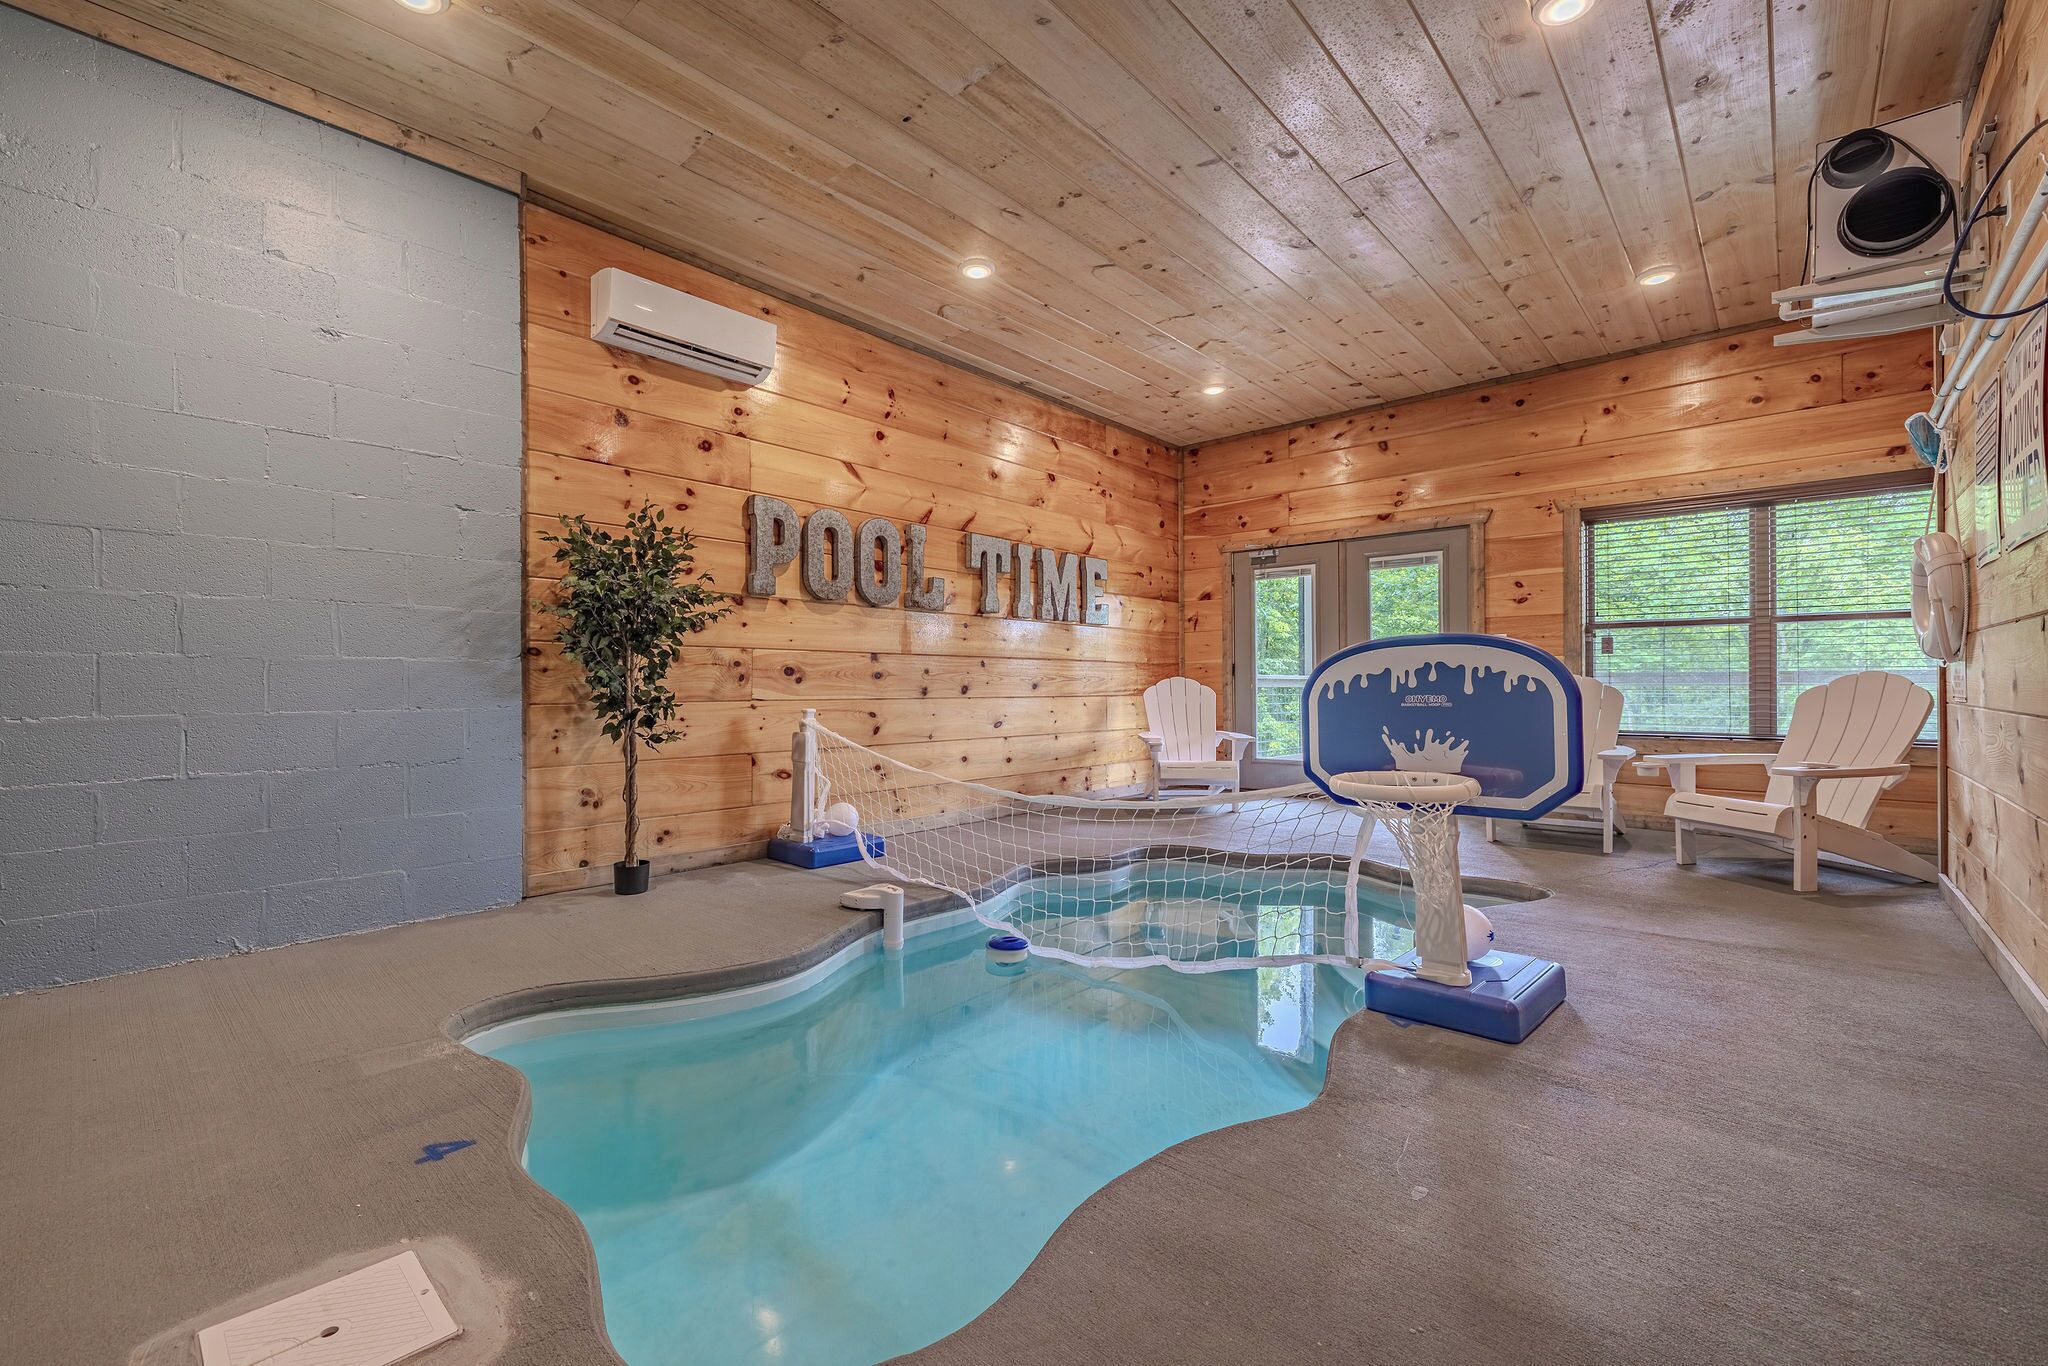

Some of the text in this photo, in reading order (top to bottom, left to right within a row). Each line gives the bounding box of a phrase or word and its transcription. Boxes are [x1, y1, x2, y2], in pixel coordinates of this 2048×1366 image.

[2004, 411, 2012, 470] NO
[2013, 379, 2039, 459] DIVING
[746, 494, 1109, 625] POOL TIME
